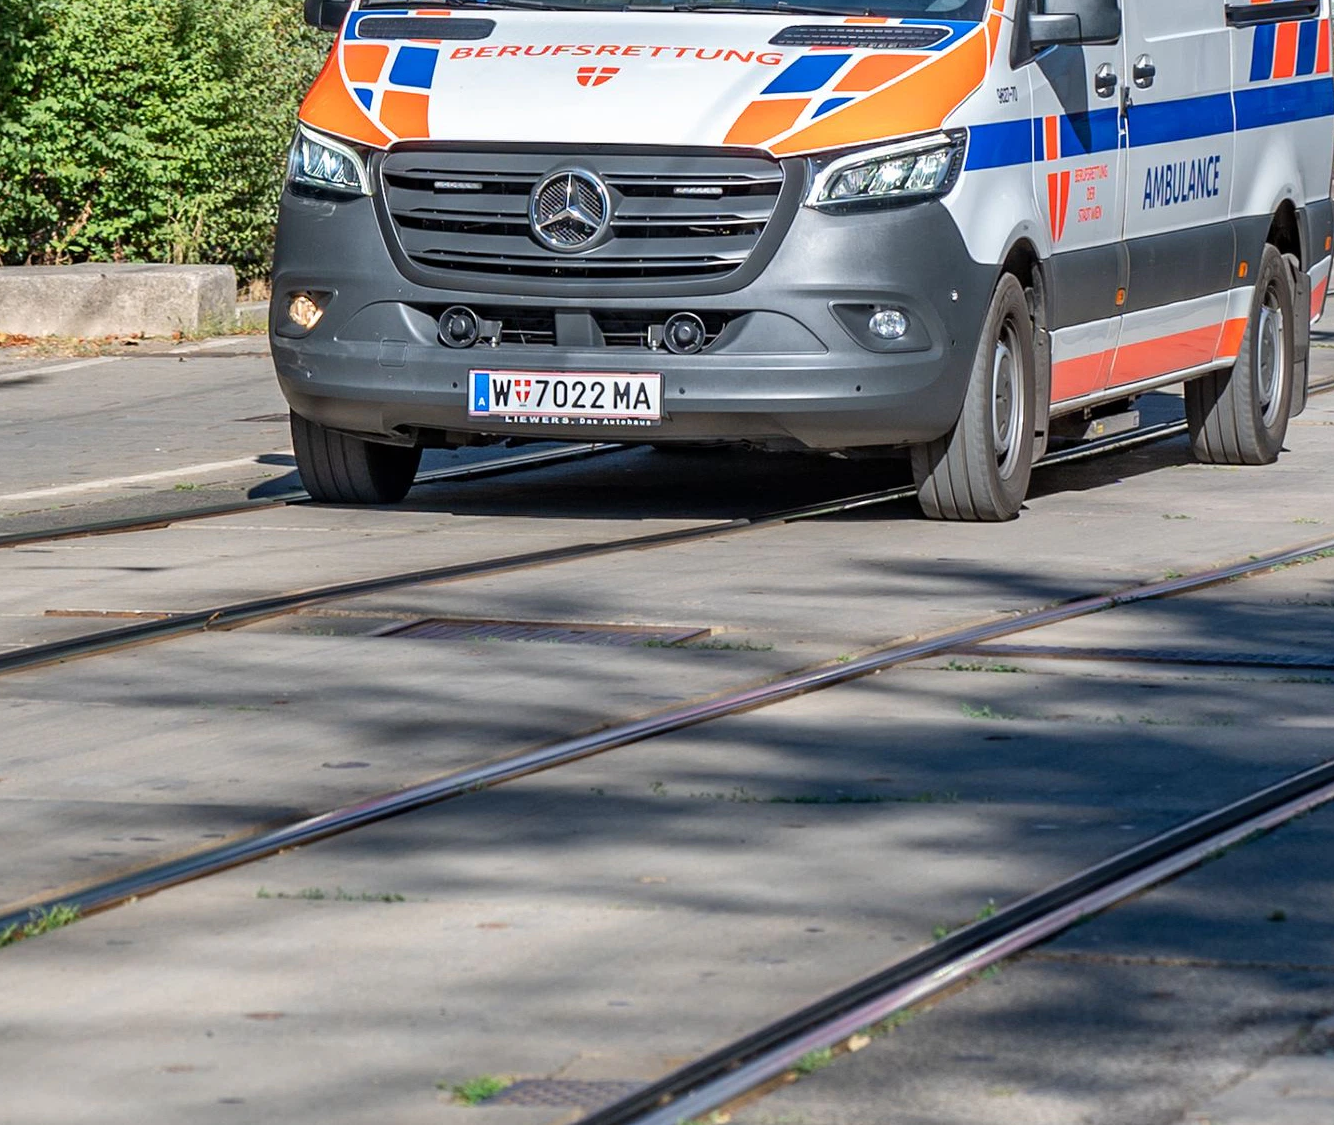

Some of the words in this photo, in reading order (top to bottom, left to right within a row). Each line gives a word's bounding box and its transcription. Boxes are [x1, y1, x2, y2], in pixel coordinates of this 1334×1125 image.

[449, 44, 785, 65] BERUFSRETTUNG
[1075, 165, 1108, 183] BERUFSRETTUNG
[1143, 155, 1220, 210] AMBULANCE
[478, 397, 486, 407] A
[492, 379, 511, 407] W
[535, 380, 605, 408] 7022
[613, 381, 651, 410] MA
[505, 415, 575, 424] LIEWERS.
[579, 417, 600, 425] Das
[602, 418, 652, 426] Autohaus
